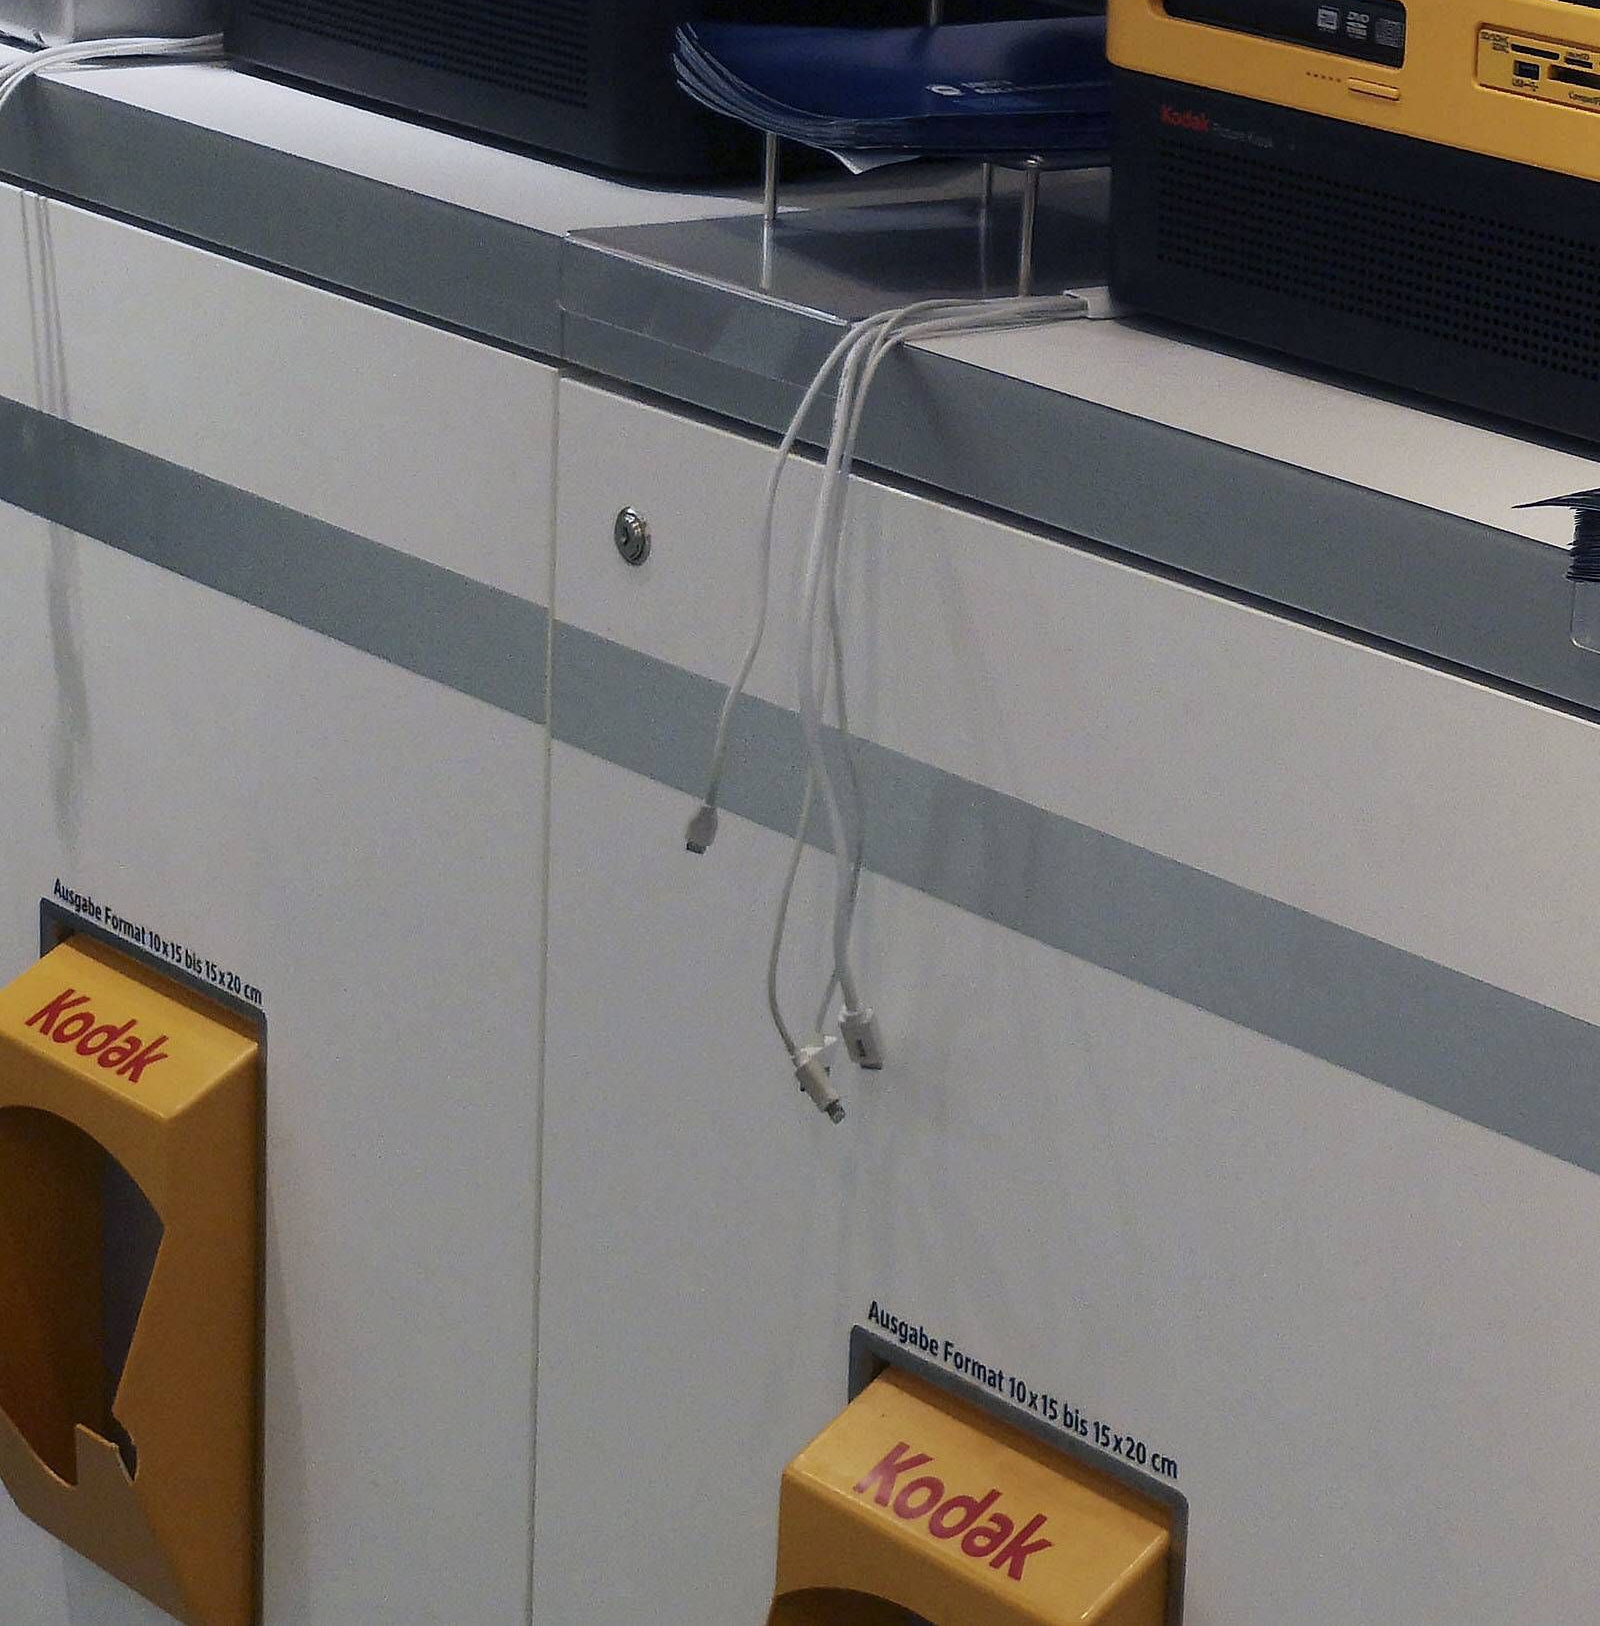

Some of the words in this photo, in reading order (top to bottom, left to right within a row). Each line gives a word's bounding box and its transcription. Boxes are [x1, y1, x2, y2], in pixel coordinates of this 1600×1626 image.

[54, 878, 101, 920] Ausgabe
[105, 907, 147, 946] Format
[185, 950, 202, 974] bis
[244, 985, 263, 1004] cm
[25, 989, 169, 1083] Kodak
[869, 1301, 938, 1356] Ausgabe
[944, 1341, 1004, 1391] Format
[1063, 1403, 1088, 1436] bis
[1151, 1454, 1178, 1479] cm
[852, 1441, 1053, 1582] Kodak
